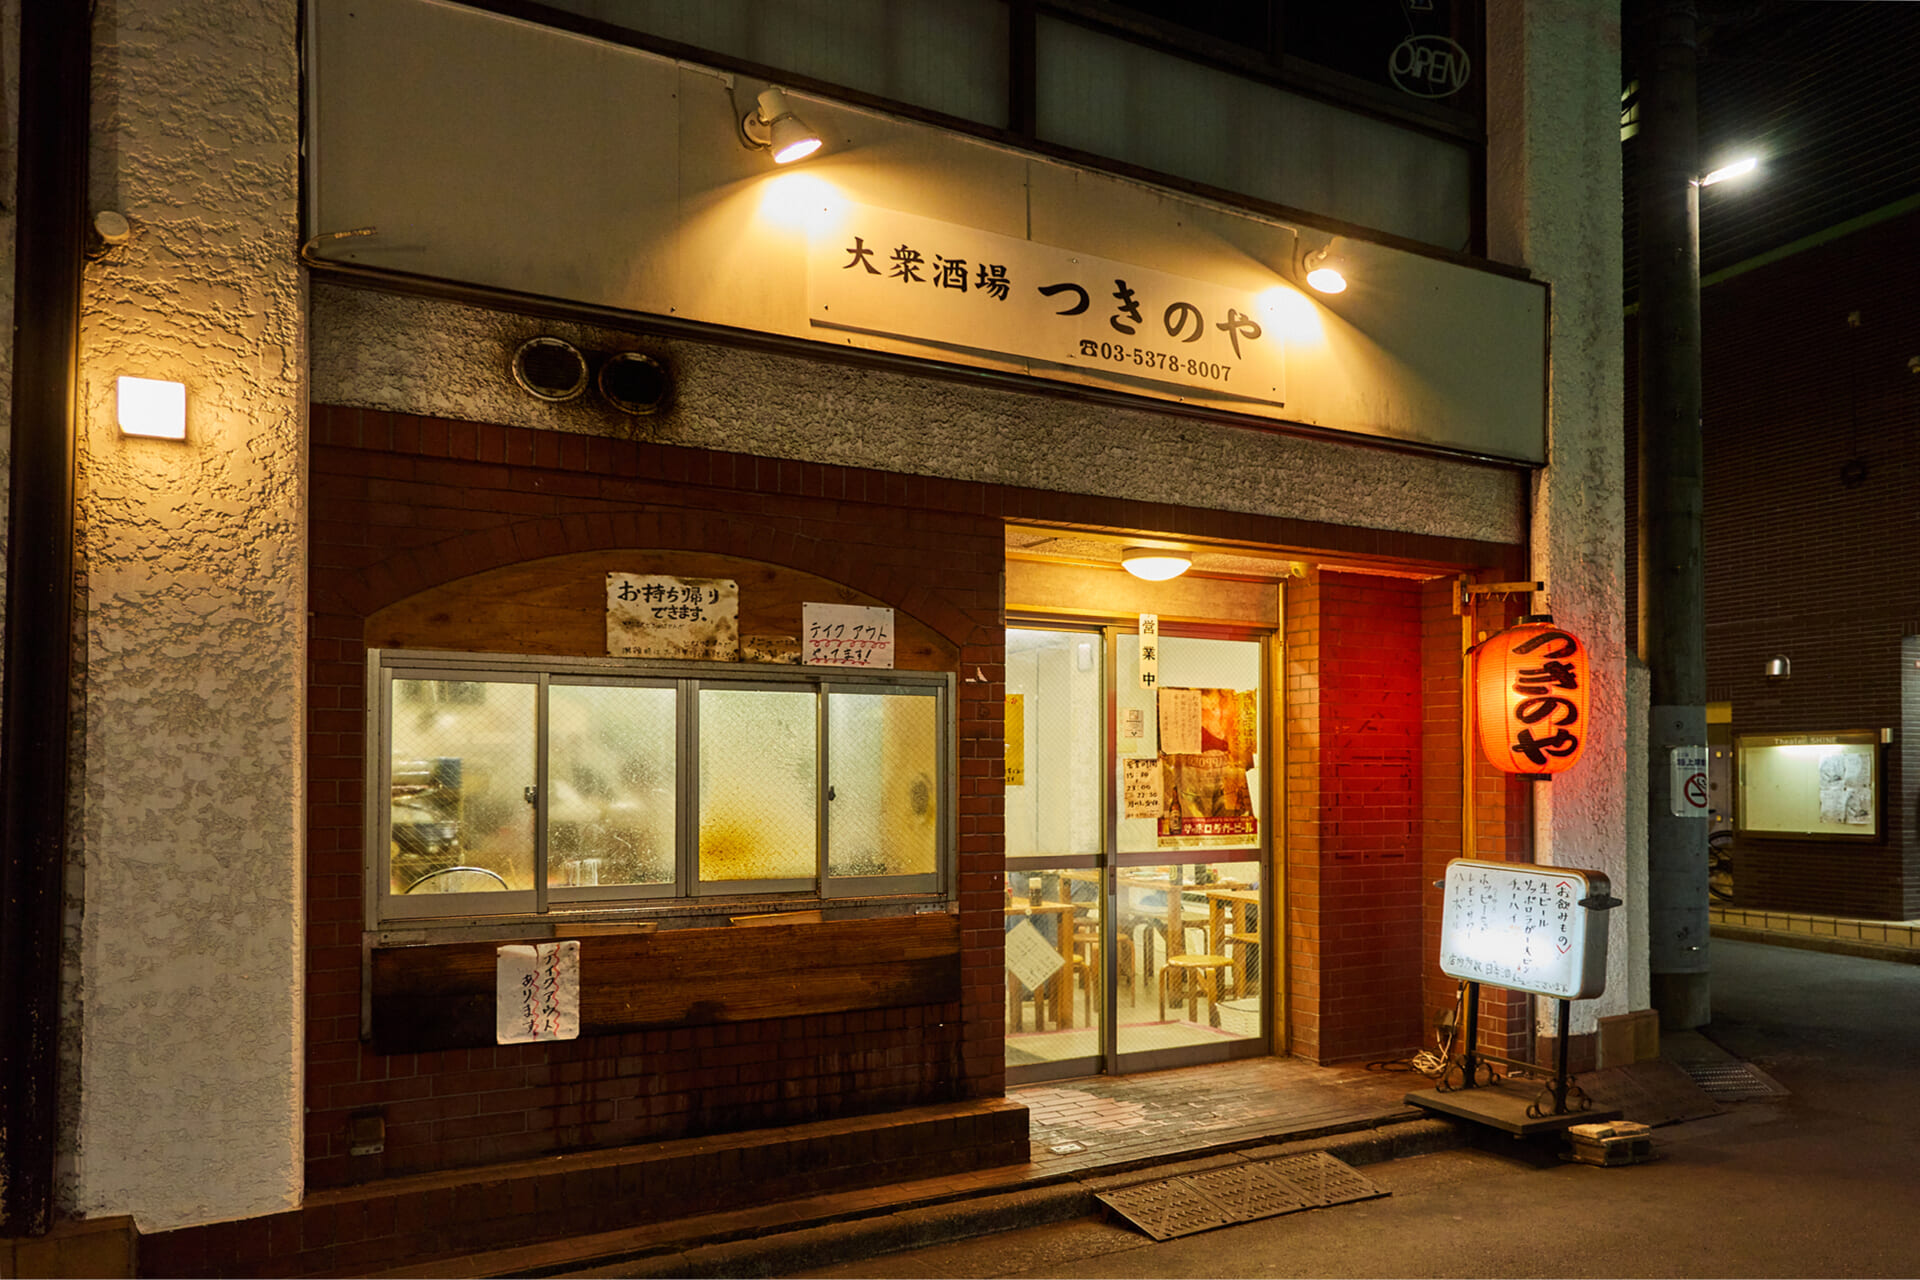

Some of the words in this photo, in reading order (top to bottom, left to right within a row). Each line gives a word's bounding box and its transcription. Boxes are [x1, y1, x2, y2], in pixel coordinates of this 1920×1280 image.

[1393, 41, 1466, 88] OPEN
[843, 236, 1011, 300] 大衆酒場
[1038, 279, 1262, 360] つきのや
[1101, 341, 1231, 382] 03-5378-8007
[617, 580, 719, 605] お持ち帰り
[1142, 619, 1156, 687] 営業中
[1512, 631, 1579, 765] つきのや
[1539, 882, 1551, 928] 生ビール
[543, 949, 555, 1032] テイクアウト
